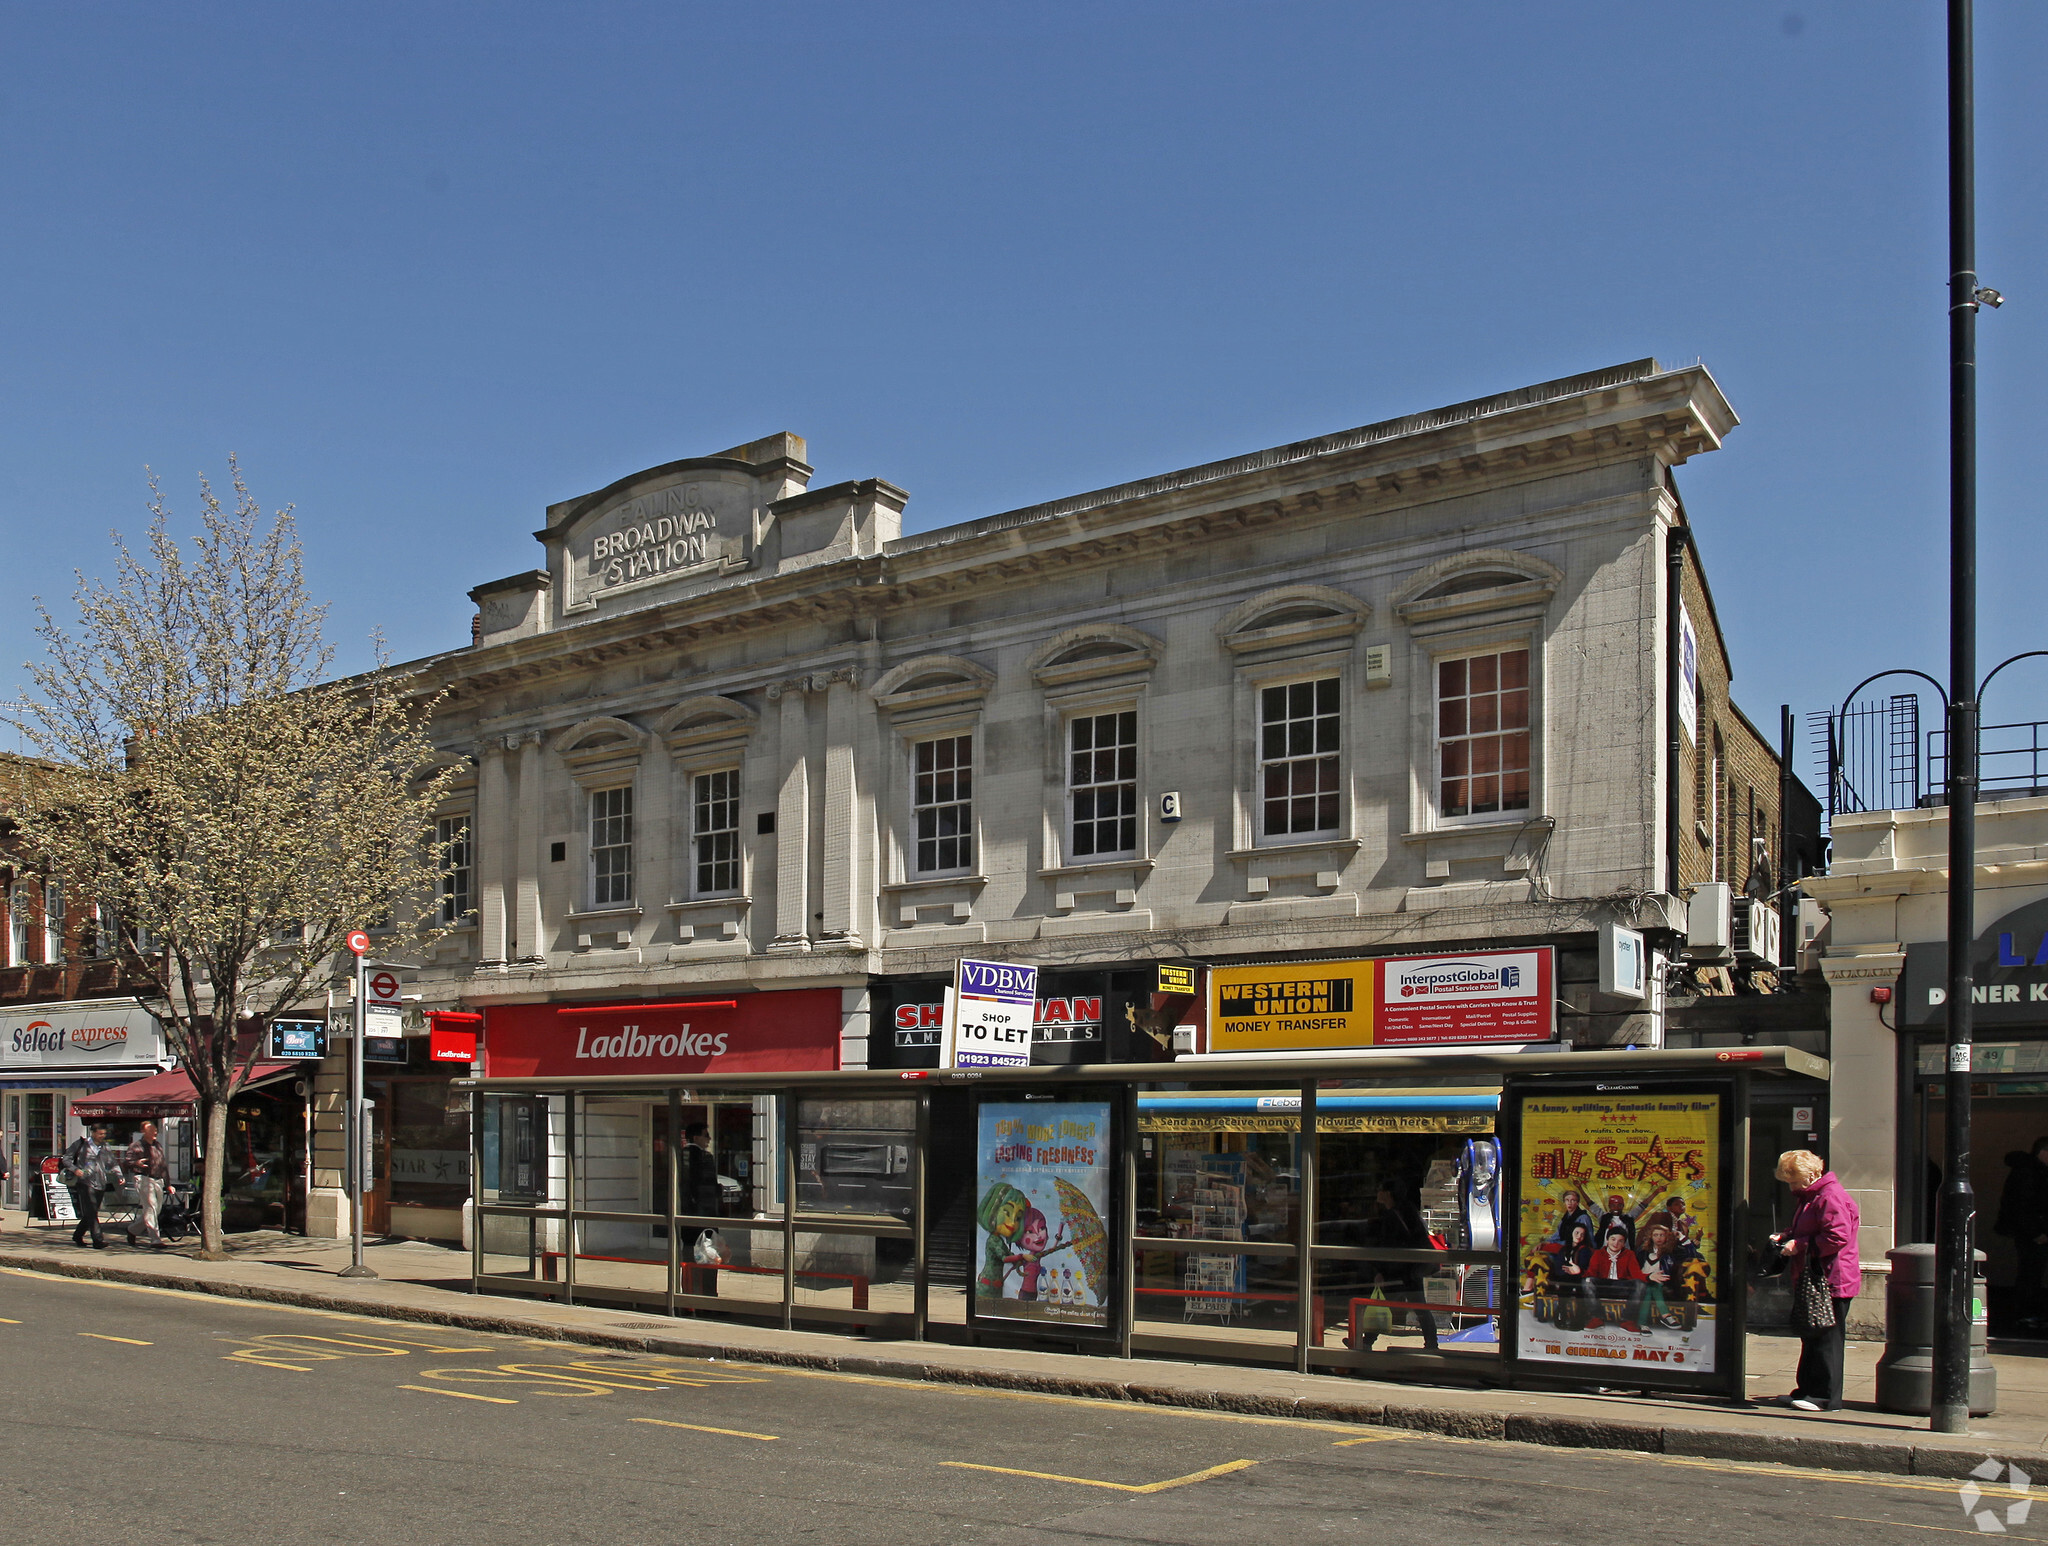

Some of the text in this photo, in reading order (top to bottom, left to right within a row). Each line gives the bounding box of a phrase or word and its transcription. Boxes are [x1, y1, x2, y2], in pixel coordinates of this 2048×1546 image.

[594, 506, 718, 560] BROADWAY
[608, 533, 707, 582] STATION
[351, 934, 365, 950] C
[962, 964, 1035, 991] VDBM
[1401, 969, 1499, 993] InterpostGlobal
[1221, 981, 1328, 1000] WESTERN
[1434, 985, 1454, 993] Postal
[1455, 984, 1479, 992] Service
[1928, 984, 2021, 1006] DNER
[1254, 998, 1328, 1015] UNION
[982, 1013, 1011, 1024] SHOP
[1225, 1018, 1347, 1033] MONEY TRANSFER
[12, 1026, 128, 1052] Select express
[575, 1023, 729, 1059] Ladbrokes
[962, 1024, 1028, 1043] TO LET
[437, 1050, 471, 1059] Ladbrokes
[958, 1054, 1027, 1067] 01923 845222
[1659, 1102, 1688, 1112] family
[1160, 1117, 1187, 1126] Send
[1190, 1117, 1211, 1126] and
[1214, 1117, 1254, 1126] receive
[1257, 1117, 1296, 1129] money
[1367, 1116, 1397, 1127] from
[1400, 1116, 1429, 1127] here
[1191, 1302, 1203, 1310] EL
[1545, 1345, 1561, 1354] IN
[1566, 1346, 1627, 1359] CINEMAS
[1633, 1349, 1670, 1362] MAY
[1673, 1352, 1685, 1363] 3
